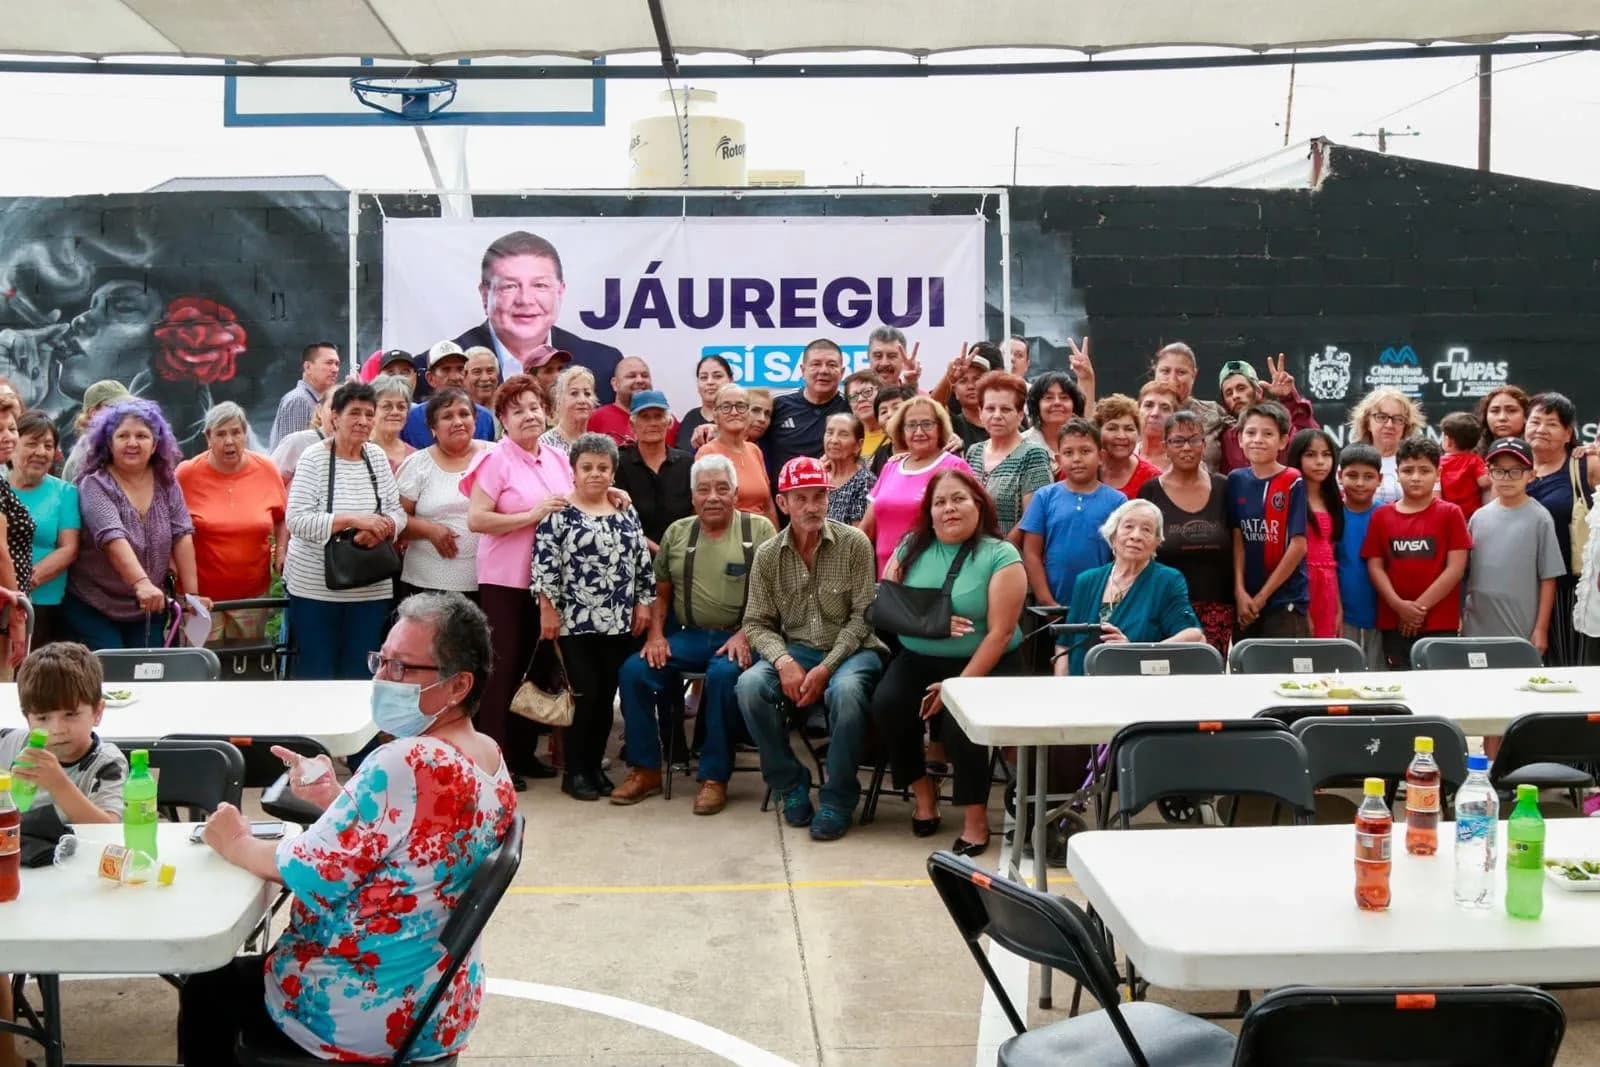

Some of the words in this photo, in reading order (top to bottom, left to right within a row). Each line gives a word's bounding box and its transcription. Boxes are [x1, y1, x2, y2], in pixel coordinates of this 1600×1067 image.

[579, 261, 944, 330] JÁUREGUI
[719, 344, 755, 382] SÍ
[1371, 365, 1422, 376] Chihuahua
[1450, 362, 1508, 381] IMPAS
[1393, 540, 1429, 551] NASA
